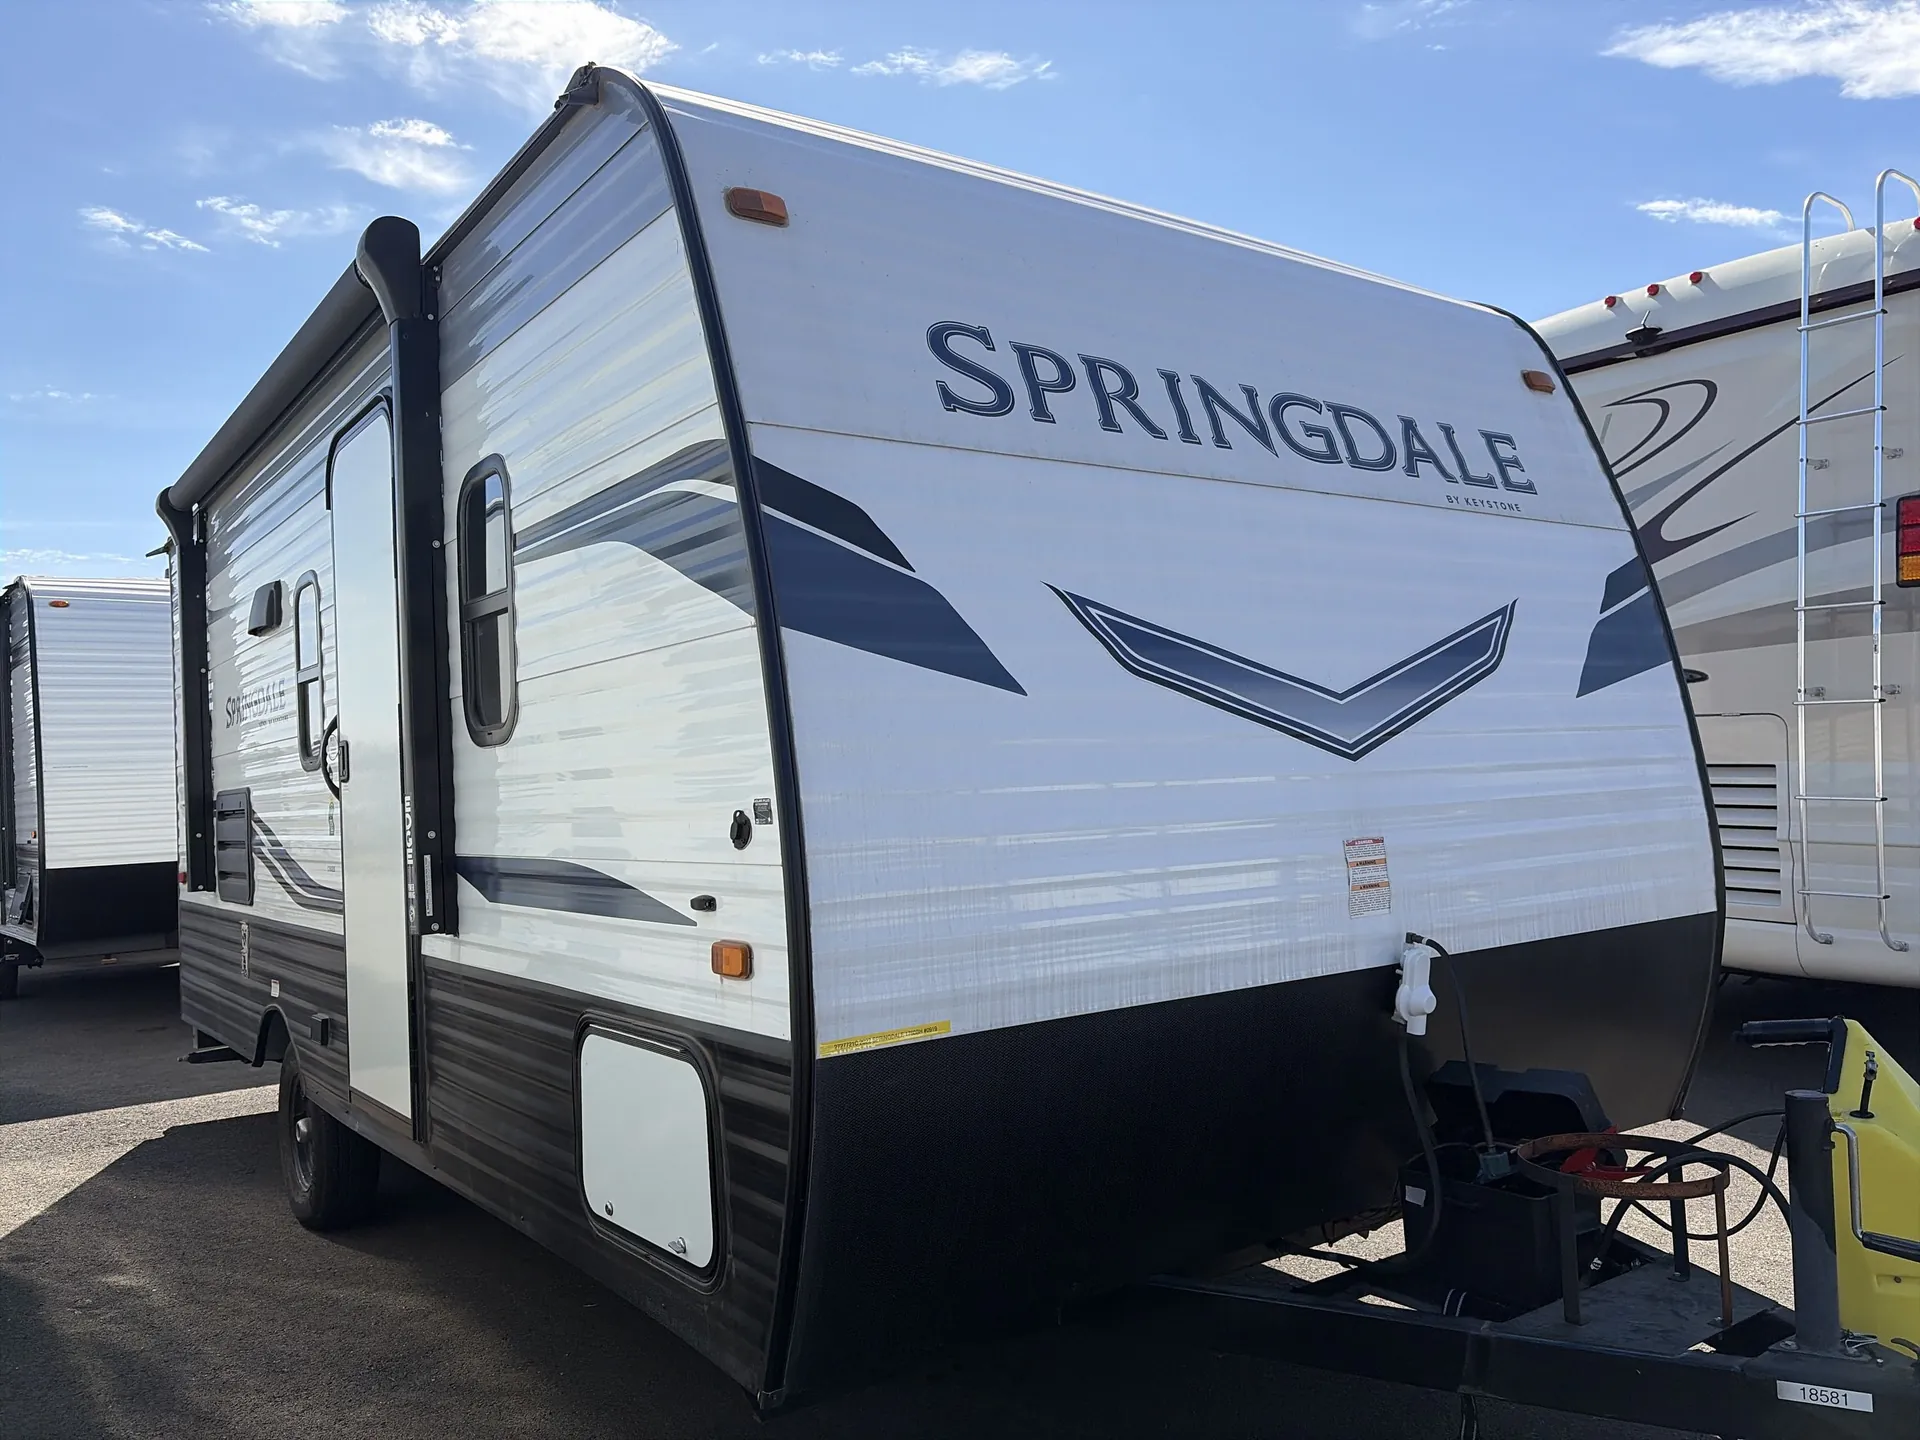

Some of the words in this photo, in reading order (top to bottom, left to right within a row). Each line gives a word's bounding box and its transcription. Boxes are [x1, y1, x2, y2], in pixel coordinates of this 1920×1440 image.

[926, 320, 1538, 495] SPRINGDALE
[1446, 495, 1460, 504] BY
[1464, 497, 1521, 512] KEYSTONE
[226, 680, 286, 729] SPRINGDALE
[1800, 1387, 1848, 1406] 18581
